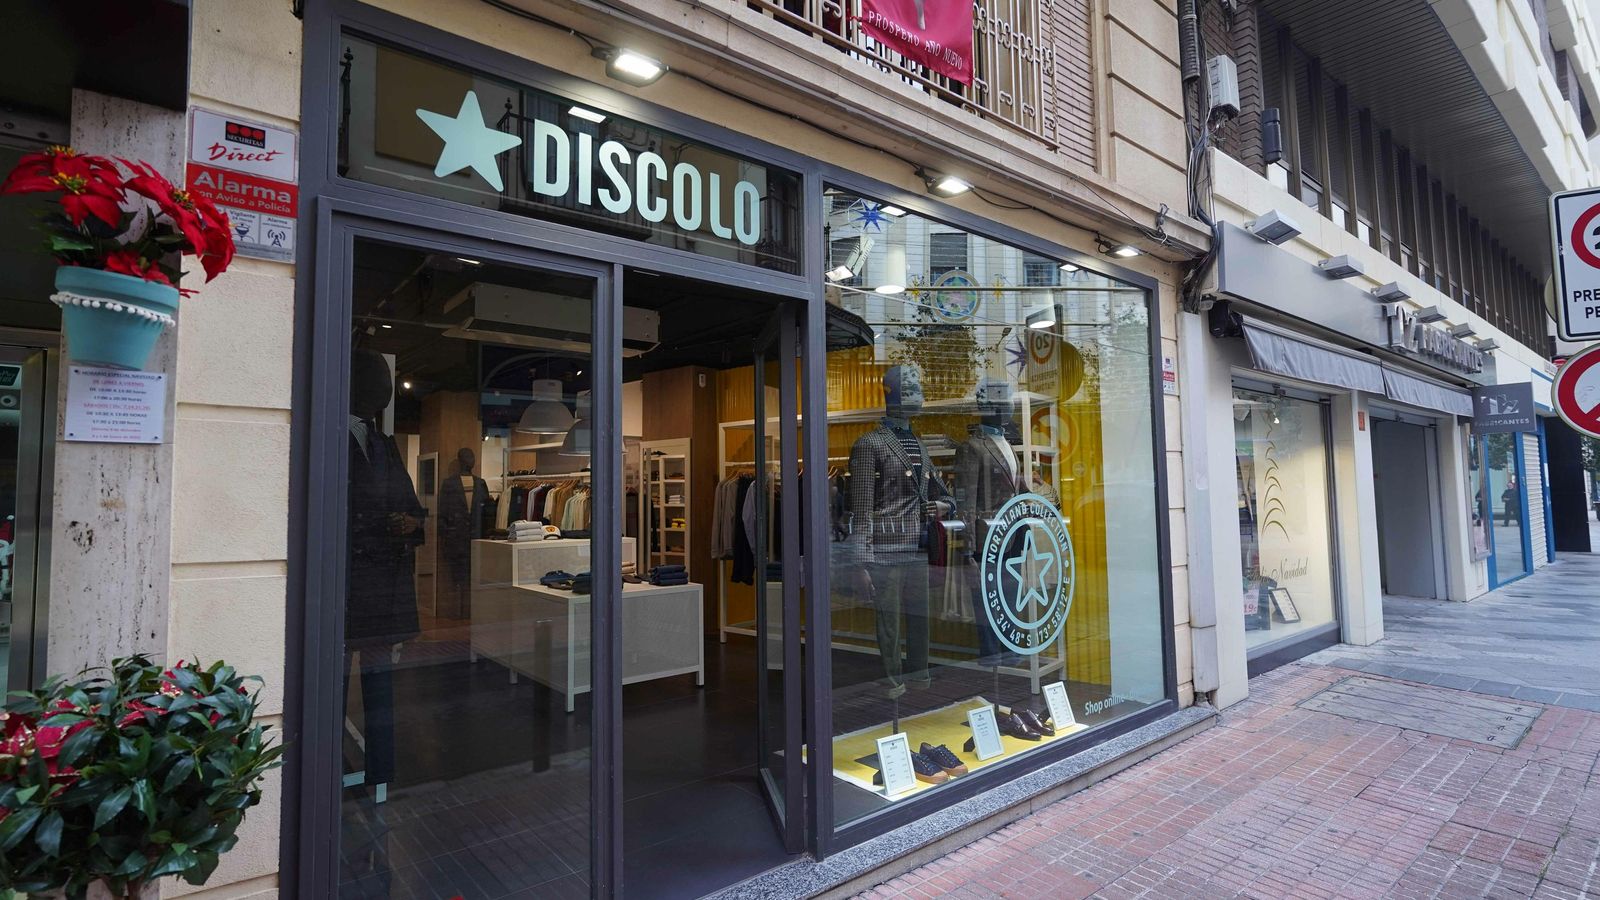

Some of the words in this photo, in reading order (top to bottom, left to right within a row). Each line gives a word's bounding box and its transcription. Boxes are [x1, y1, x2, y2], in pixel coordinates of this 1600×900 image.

[868, 10, 920, 46] PROSPERO
[942, 47, 963, 70] NUEVO
[208, 142, 284, 162] Direct
[227, 134, 263, 147] SECURITAS
[193, 171, 291, 203] Alarma
[533, 118, 760, 245] DISCOLO
[216, 193, 245, 205] Aviso
[987, 502, 1028, 564] NORTHLAND
[1030, 503, 1069, 553] COLLECTION
[1271, 556, 1309, 580] Navidad
[1026, 634, 1032, 646] S
[1063, 576, 1070, 584] E
[1084, 700, 1103, 716] Shop
